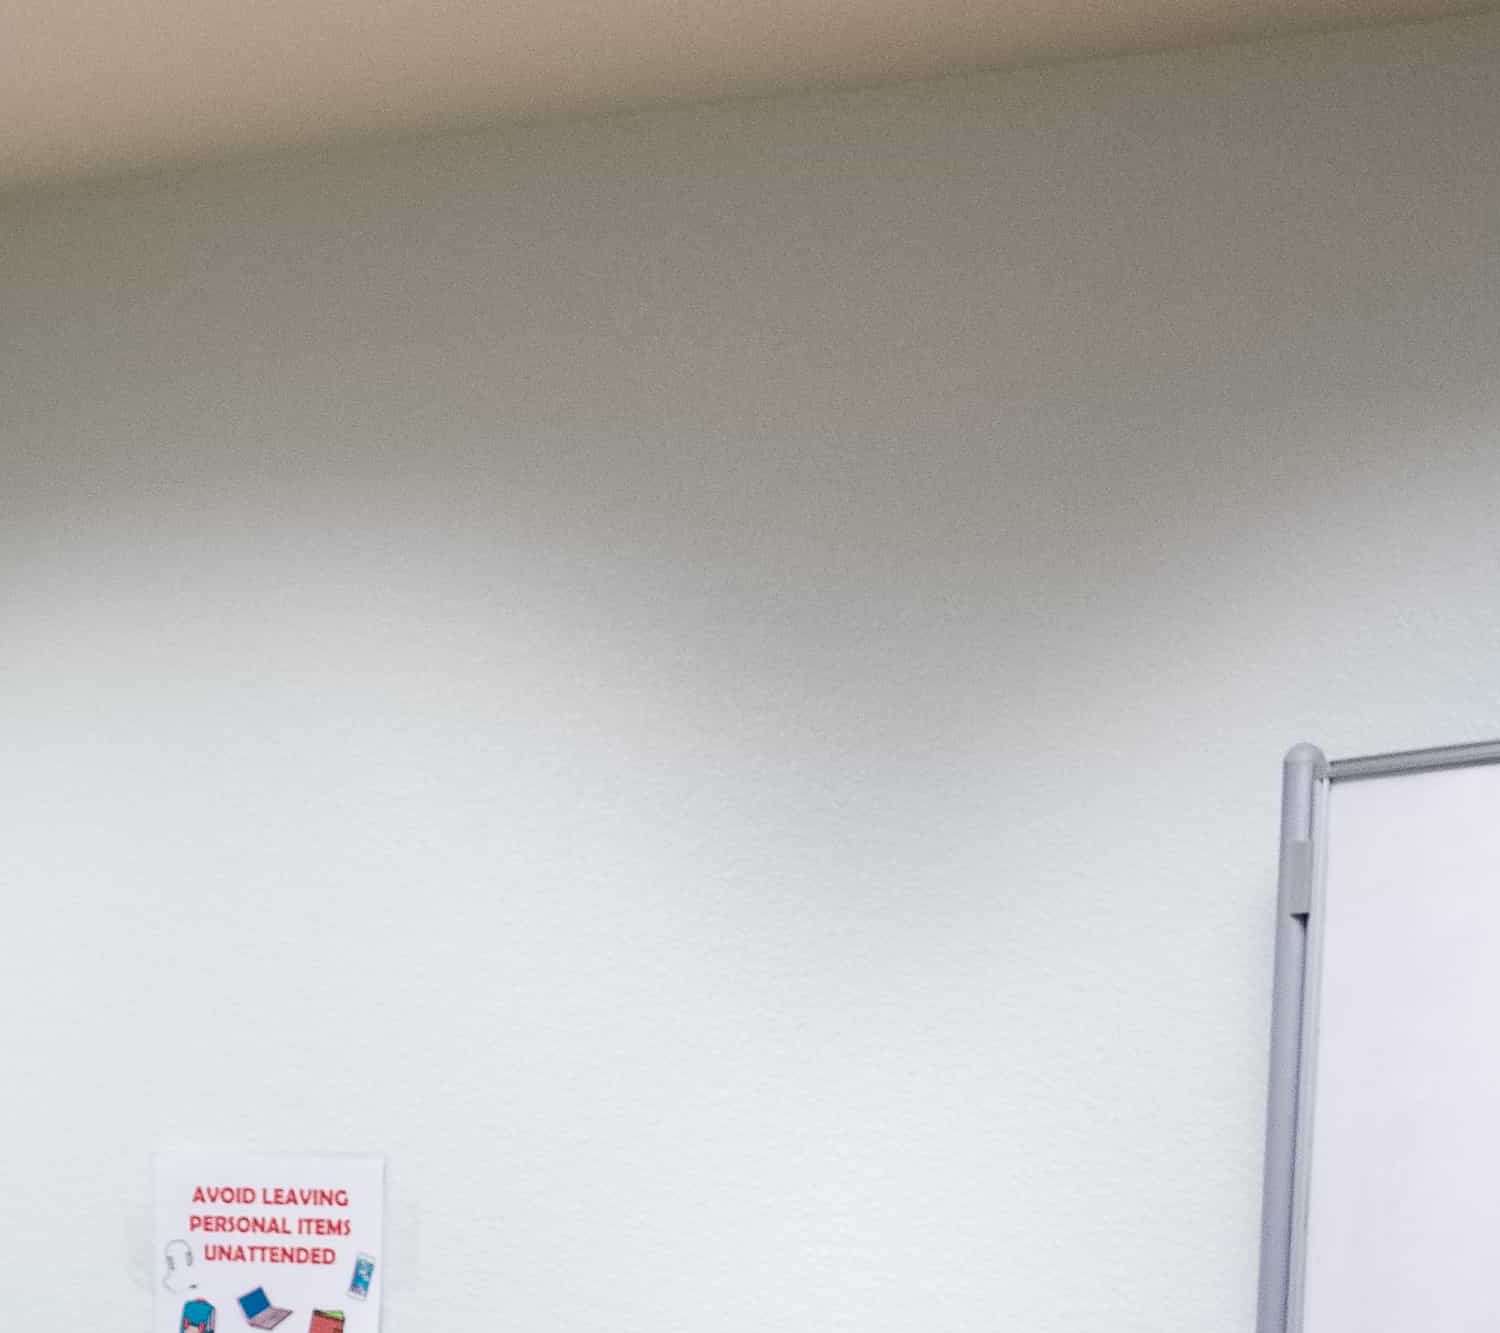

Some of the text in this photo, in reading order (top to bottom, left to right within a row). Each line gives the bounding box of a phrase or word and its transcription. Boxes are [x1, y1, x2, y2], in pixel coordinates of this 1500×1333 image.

[192, 1186, 350, 1207] AVOID LEAVING
[188, 1215, 352, 1237] PERSONAL ITEMS
[203, 1244, 337, 1265] UNATTENDED
